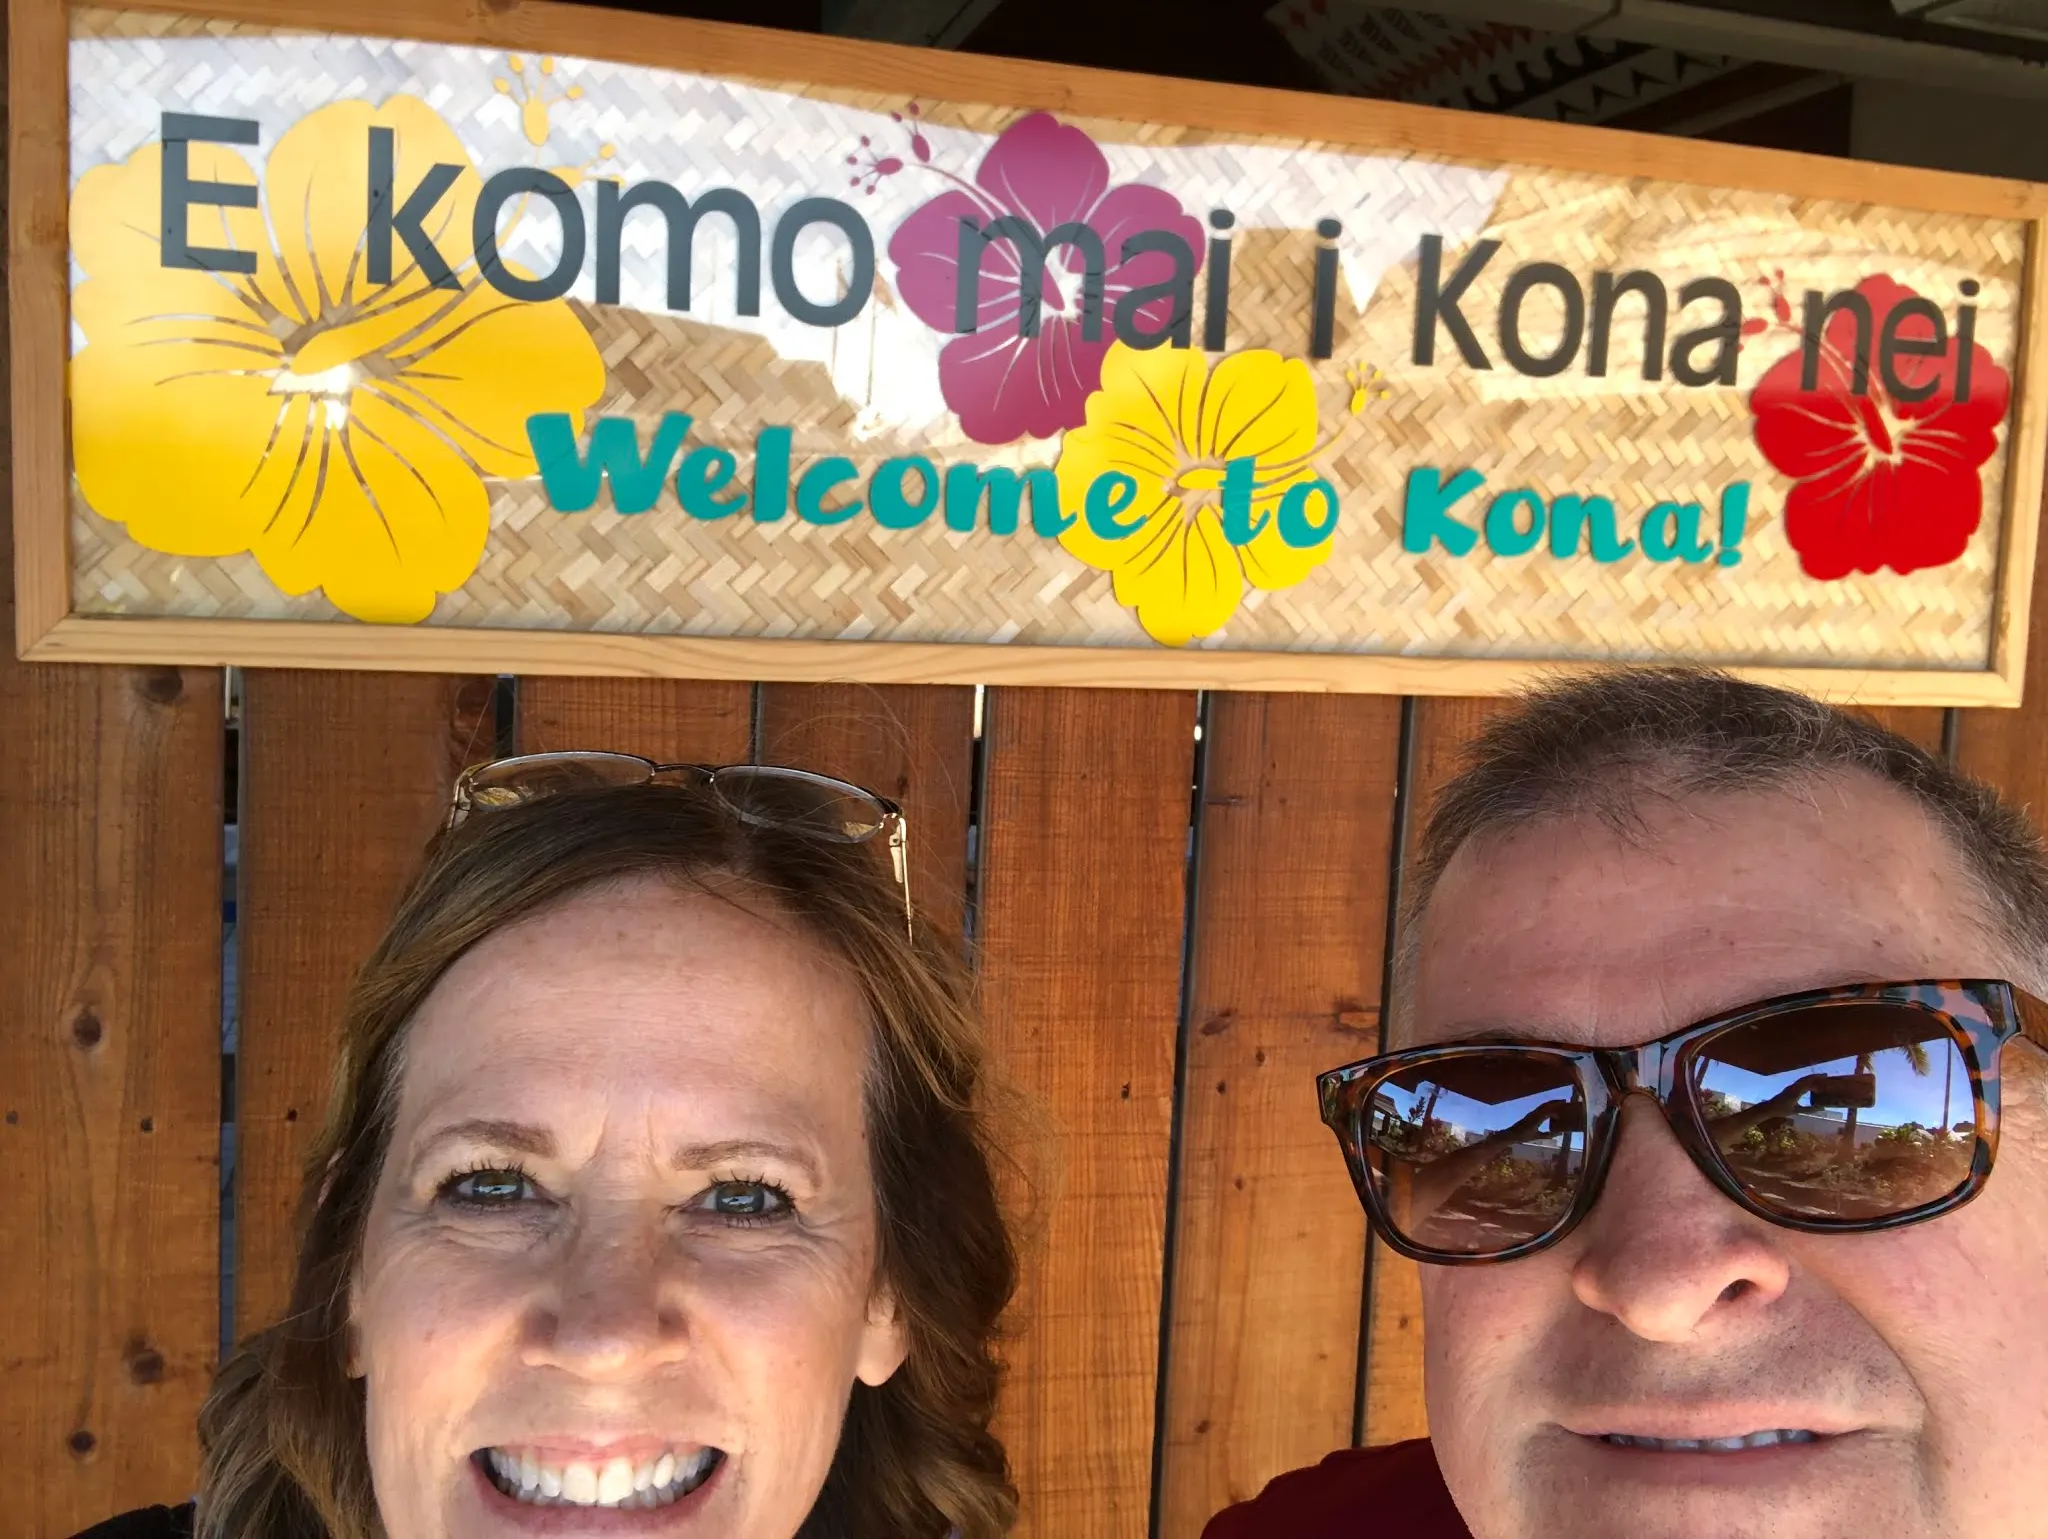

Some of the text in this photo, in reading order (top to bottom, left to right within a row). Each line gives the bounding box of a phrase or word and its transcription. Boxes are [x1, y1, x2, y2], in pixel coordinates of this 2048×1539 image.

[161, 110, 1981, 405] E komo mai i Kona nei
[526, 411, 1752, 568] Welcome to Kona!
